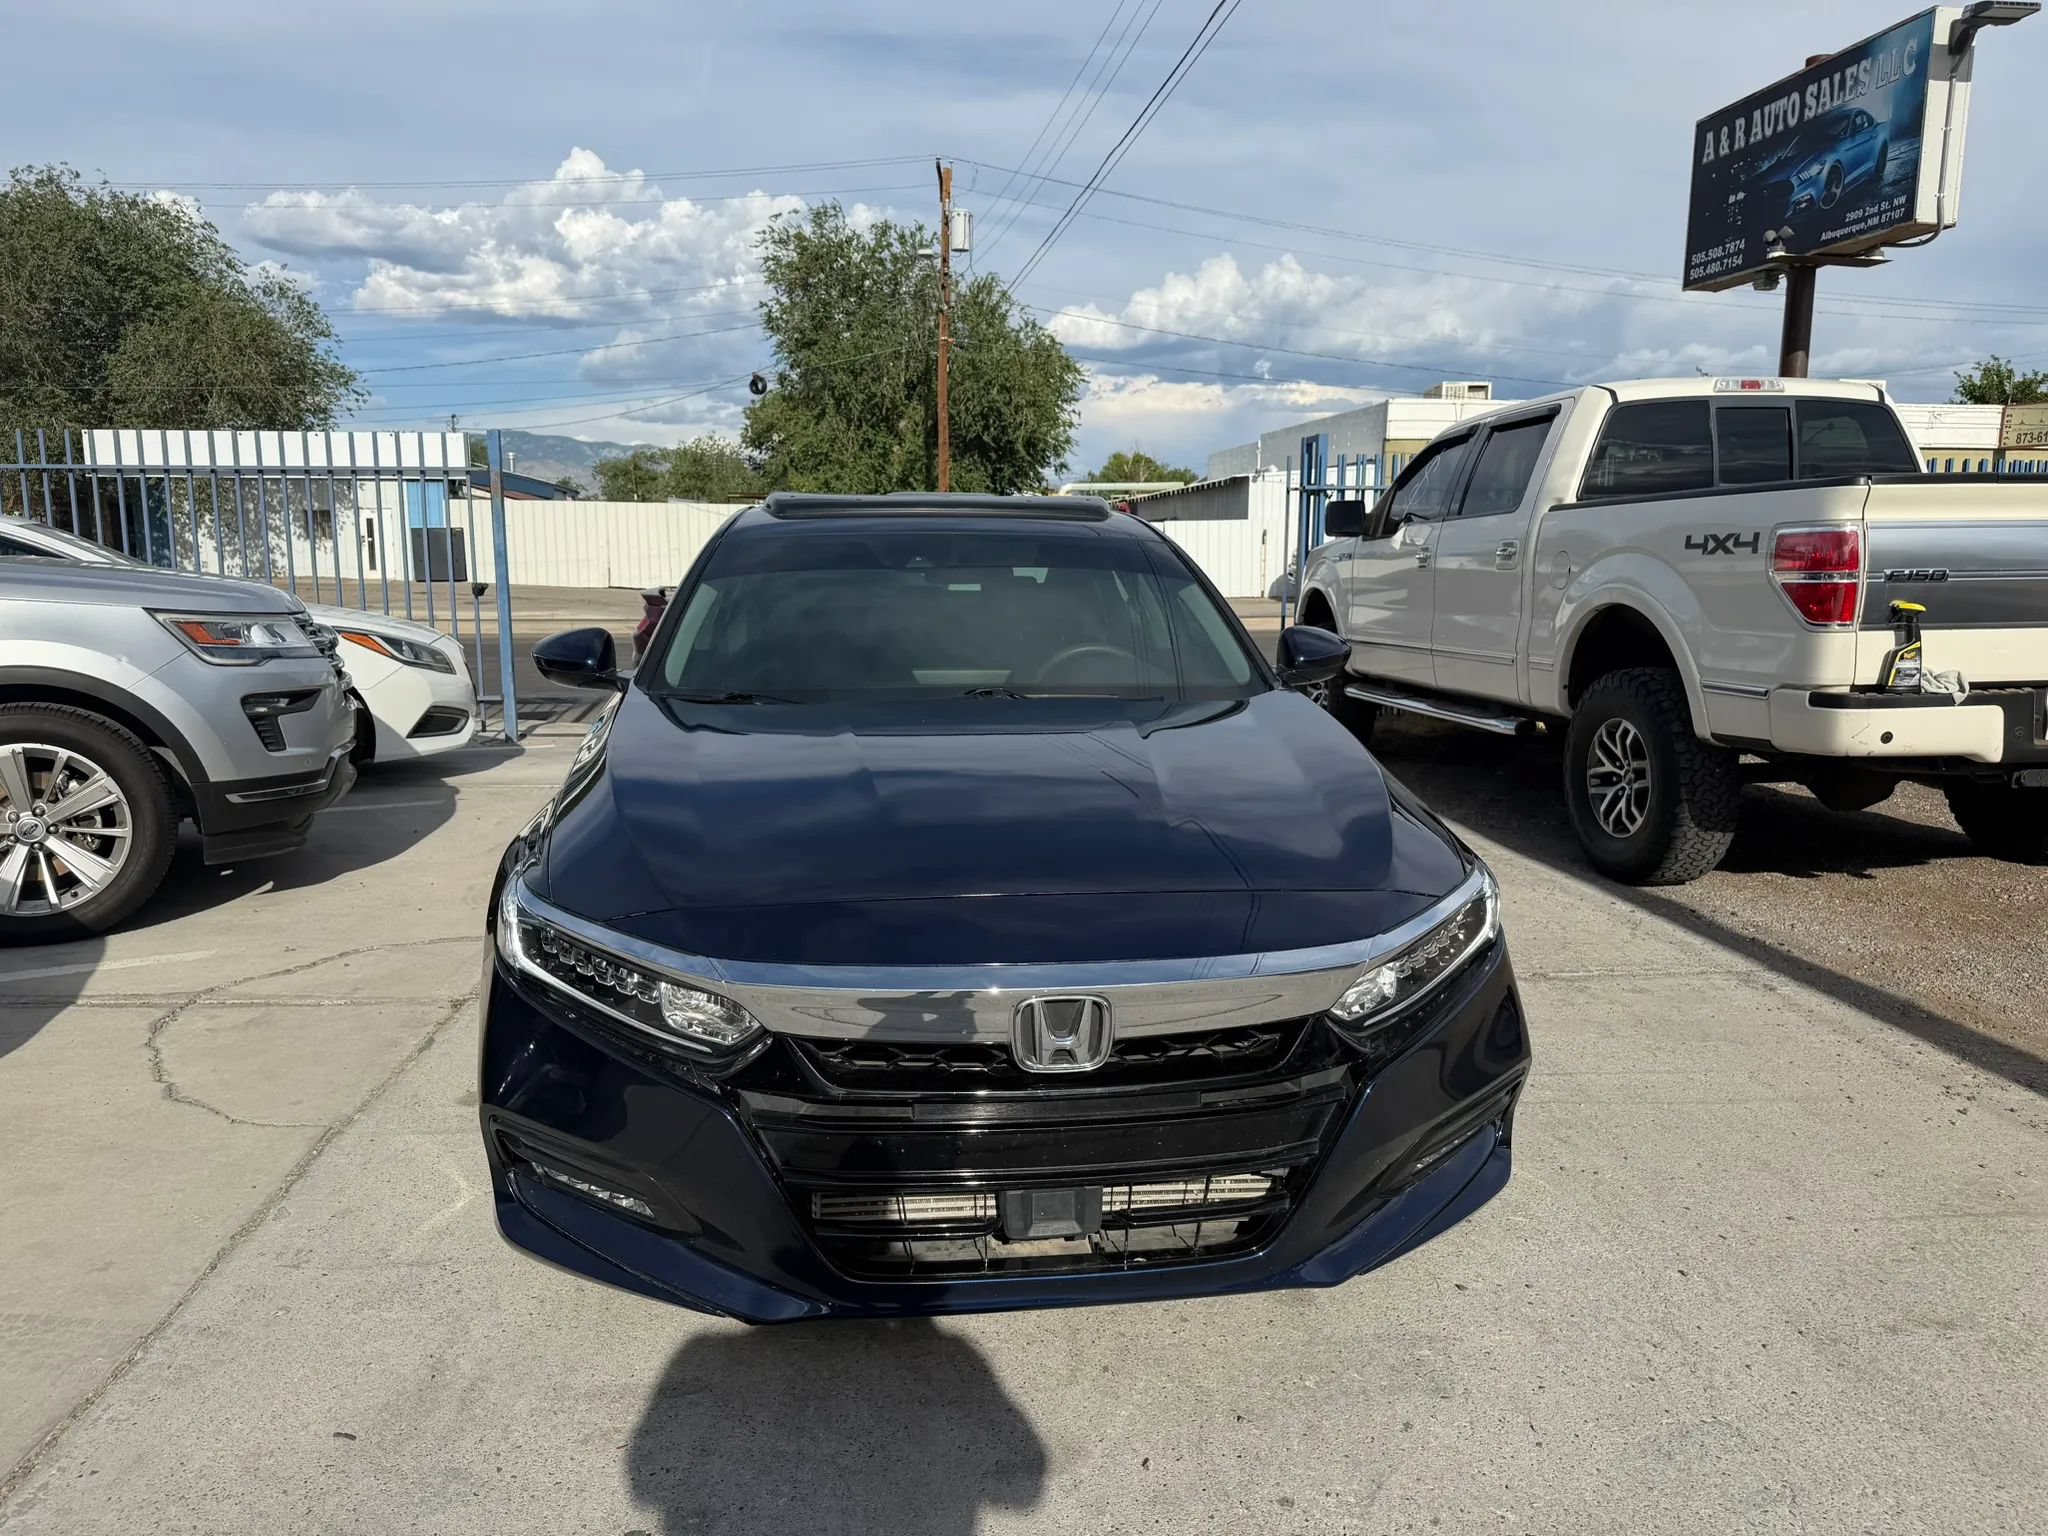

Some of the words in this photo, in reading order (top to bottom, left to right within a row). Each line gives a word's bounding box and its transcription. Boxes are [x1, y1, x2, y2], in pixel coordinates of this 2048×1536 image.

[1702, 131, 1715, 165] A
[1719, 126, 1730, 156] &
[1734, 117, 1746, 151] R
[1750, 91, 1800, 144] AUTO
[1803, 57, 1872, 122] SALES
[1875, 38, 1919, 89] LLC
[1845, 208, 1863, 222] 2909
[1865, 204, 1879, 216] 2nd
[1893, 194, 1907, 207] NW
[1881, 208, 1906, 223] 87107
[1691, 238, 1745, 266] 505.508.7874
[1689, 254, 1743, 280] 505.480.7154
